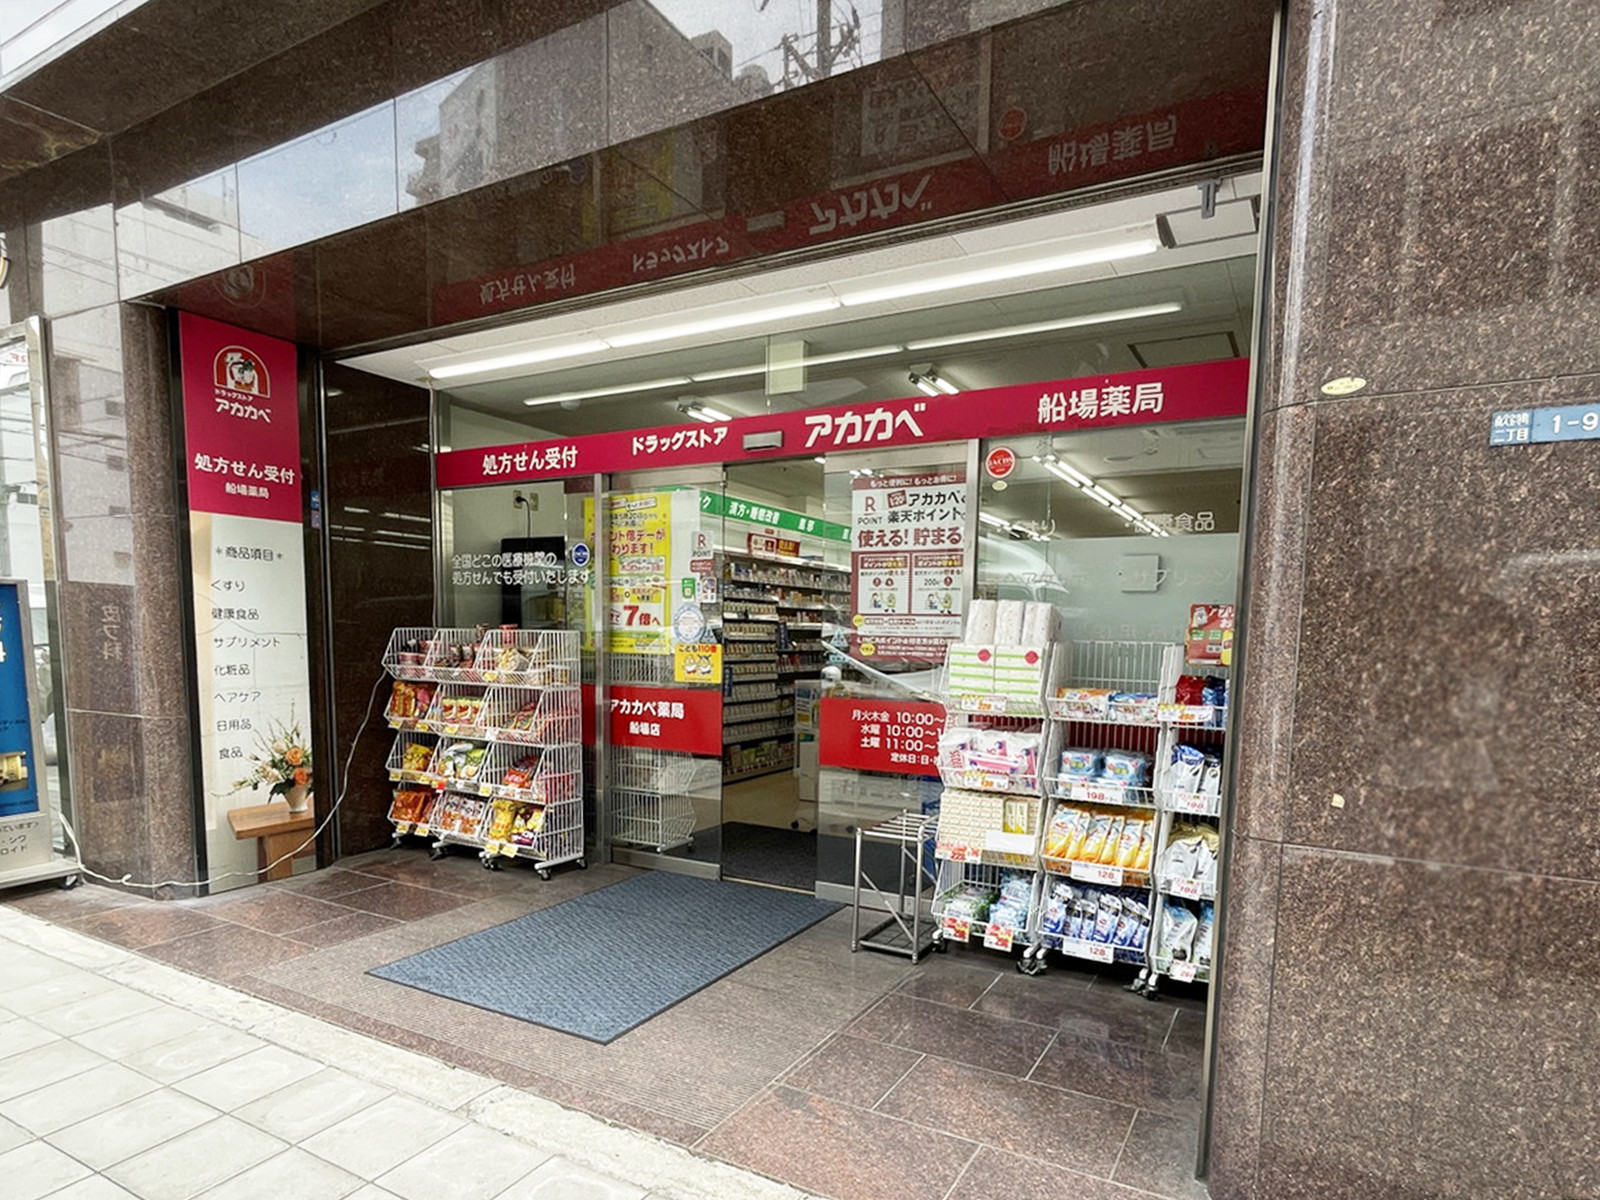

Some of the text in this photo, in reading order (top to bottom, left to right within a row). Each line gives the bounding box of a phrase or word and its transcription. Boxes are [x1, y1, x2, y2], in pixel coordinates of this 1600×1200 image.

[1037, 382, 1164, 425] 船場薬局
[215, 398, 272, 423] アカカベ
[804, 403, 927, 448] アカカベ
[1552, 412, 1599, 434] 1-9
[632, 427, 728, 455] ドラッグストア
[1494, 428, 1528, 442] 二丁目
[483, 446, 578, 475] 処方せん受付
[194, 453, 295, 485] 処方せん受付
[225, 482, 270, 499] 船場薬局
[864, 496, 876, 512] R
[211, 580, 245, 592] くすり
[211, 607, 260, 620] 健康食品
[214, 635, 281, 648] サプリメント
[214, 664, 250, 676] 化粧品
[214, 690, 261, 703] ヘアケア
[852, 709, 890, 722] 月火木金
[217, 718, 252, 731] 日用品
[861, 724, 880, 735] 水曜
[860, 737, 880, 748] 土曜
[219, 746, 243, 759] 食品
